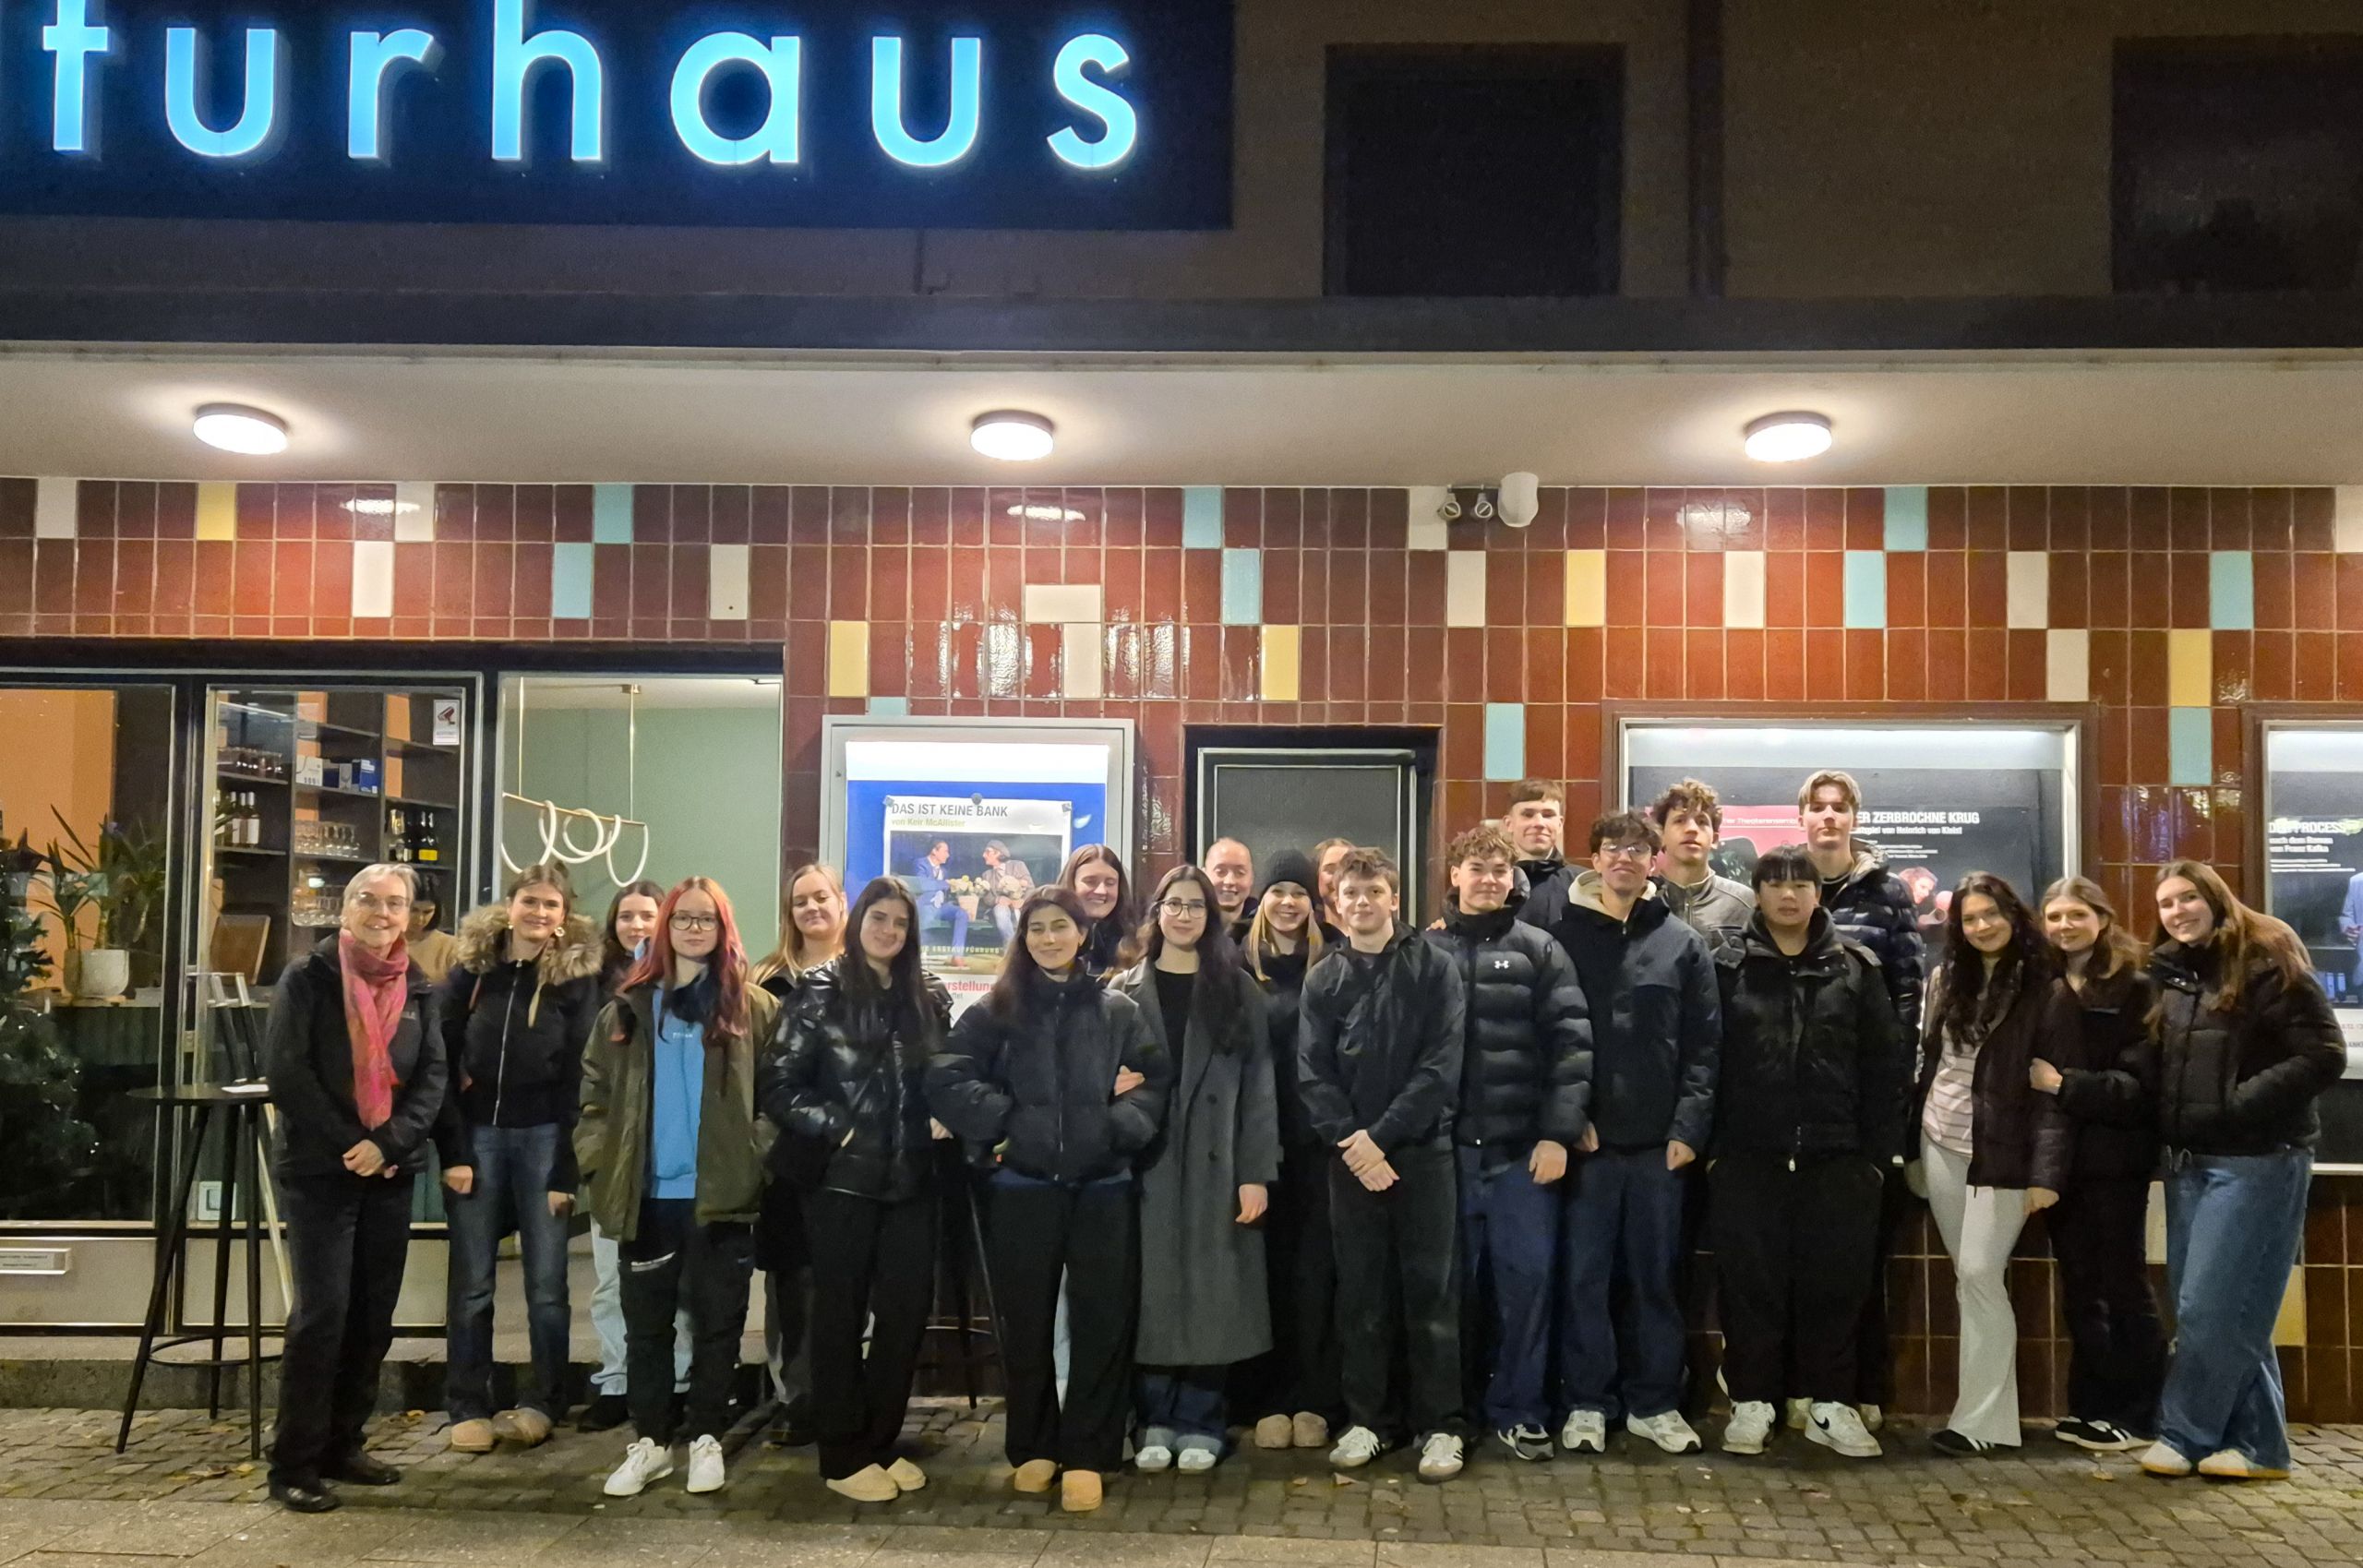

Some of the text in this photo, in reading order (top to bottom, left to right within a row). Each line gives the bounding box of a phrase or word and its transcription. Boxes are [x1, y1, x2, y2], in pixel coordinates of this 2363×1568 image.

[892, 803, 1008, 817] DAS IST KEINE BANK
[1856, 811, 1980, 824] ER ZERBROCHNE KRUG
[944, 981, 994, 991] rstellun
